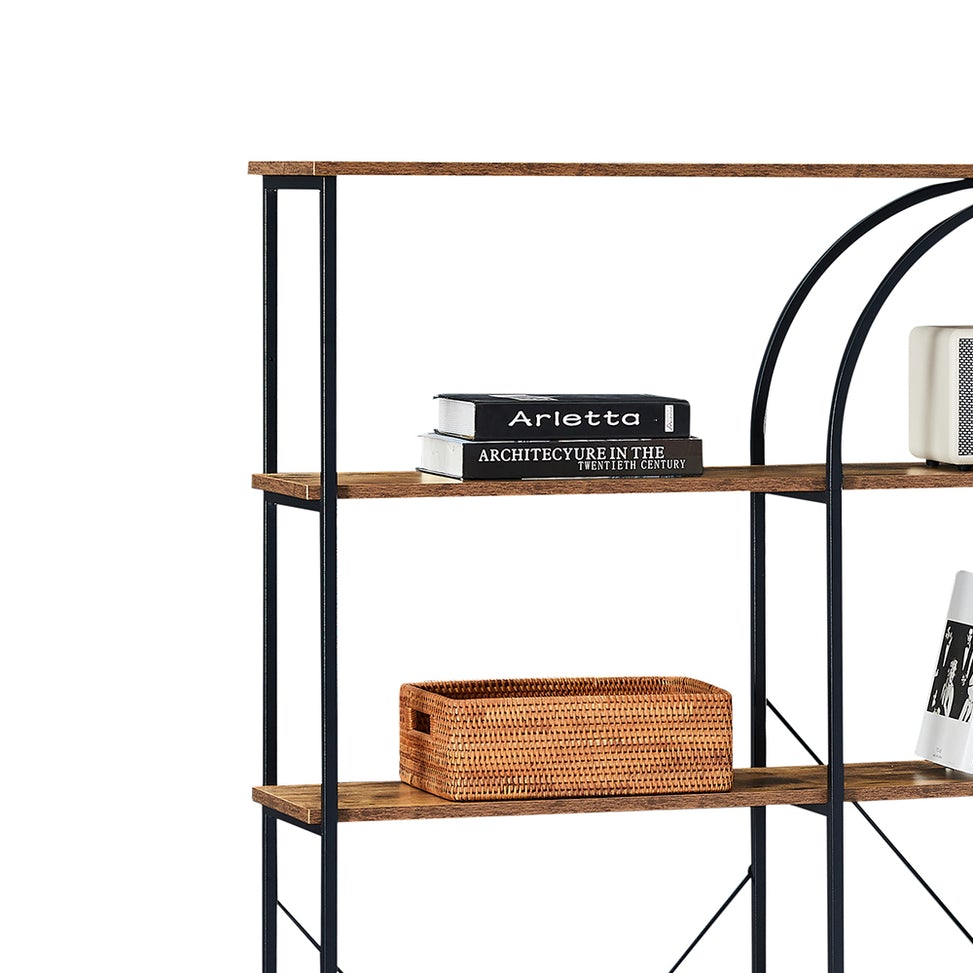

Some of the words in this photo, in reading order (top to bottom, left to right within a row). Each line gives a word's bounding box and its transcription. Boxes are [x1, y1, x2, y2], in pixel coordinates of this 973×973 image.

[478, 446, 606, 462] ARCHITECYURE
[609, 446, 627, 460] IN
[630, 446, 665, 460] THE
[578, 461, 636, 471] TWENTIETH
[640, 459, 686, 470] CENTURY
